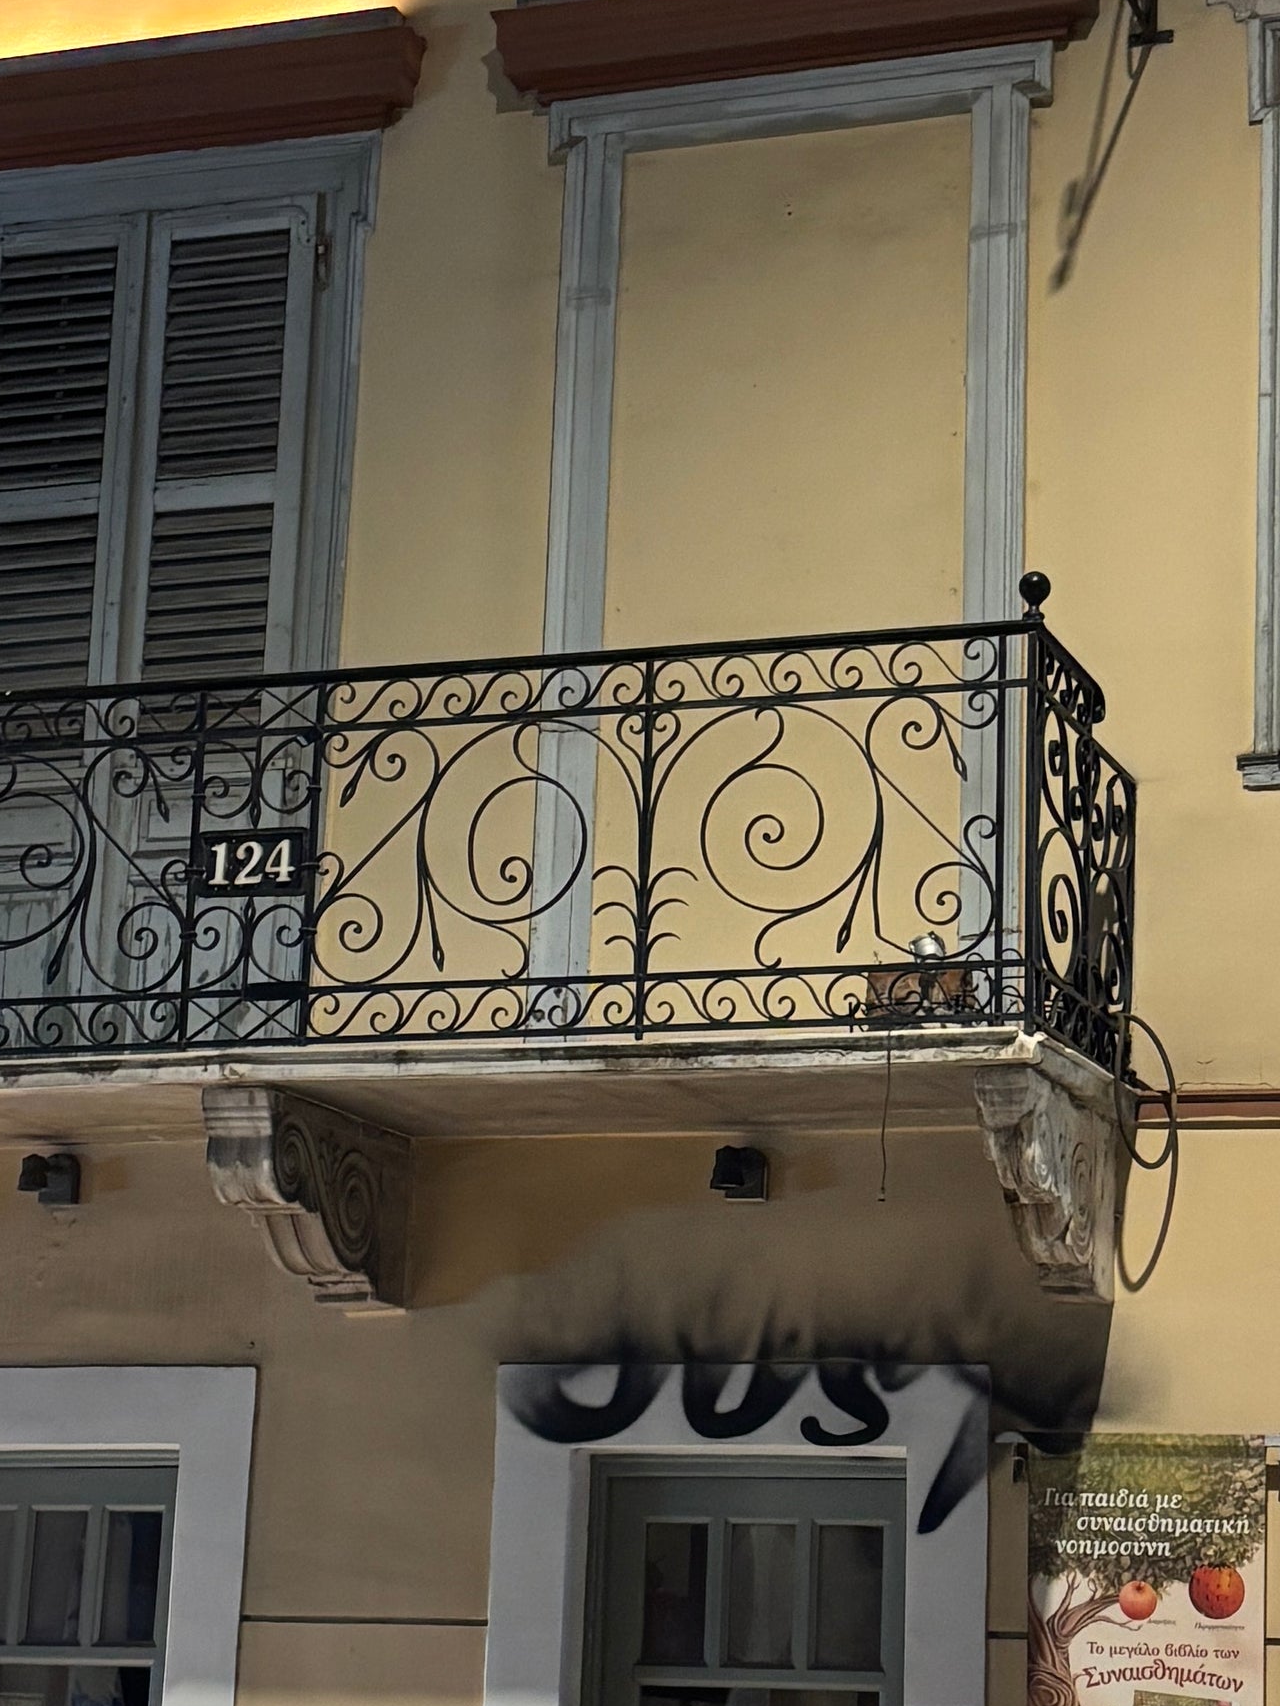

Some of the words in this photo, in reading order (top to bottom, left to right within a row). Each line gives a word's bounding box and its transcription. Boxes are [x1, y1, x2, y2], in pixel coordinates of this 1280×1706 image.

[208, 839, 296, 886] 124
[1044, 1488, 1075, 1506] Για
[1080, 1489, 1150, 1509] παιδιά
[1155, 1493, 1183, 1511] με
[1077, 1513, 1251, 1537] συναισθηματική
[1055, 1536, 1171, 1559] νοημοσύνη
[1087, 1641, 1104, 1655] Το
[1109, 1642, 1160, 1659] μεγάλο
[1165, 1643, 1208, 1658] βιβλίο
[1213, 1647, 1240, 1660] των
[1083, 1658, 1244, 1693] Συναισθημάτων
